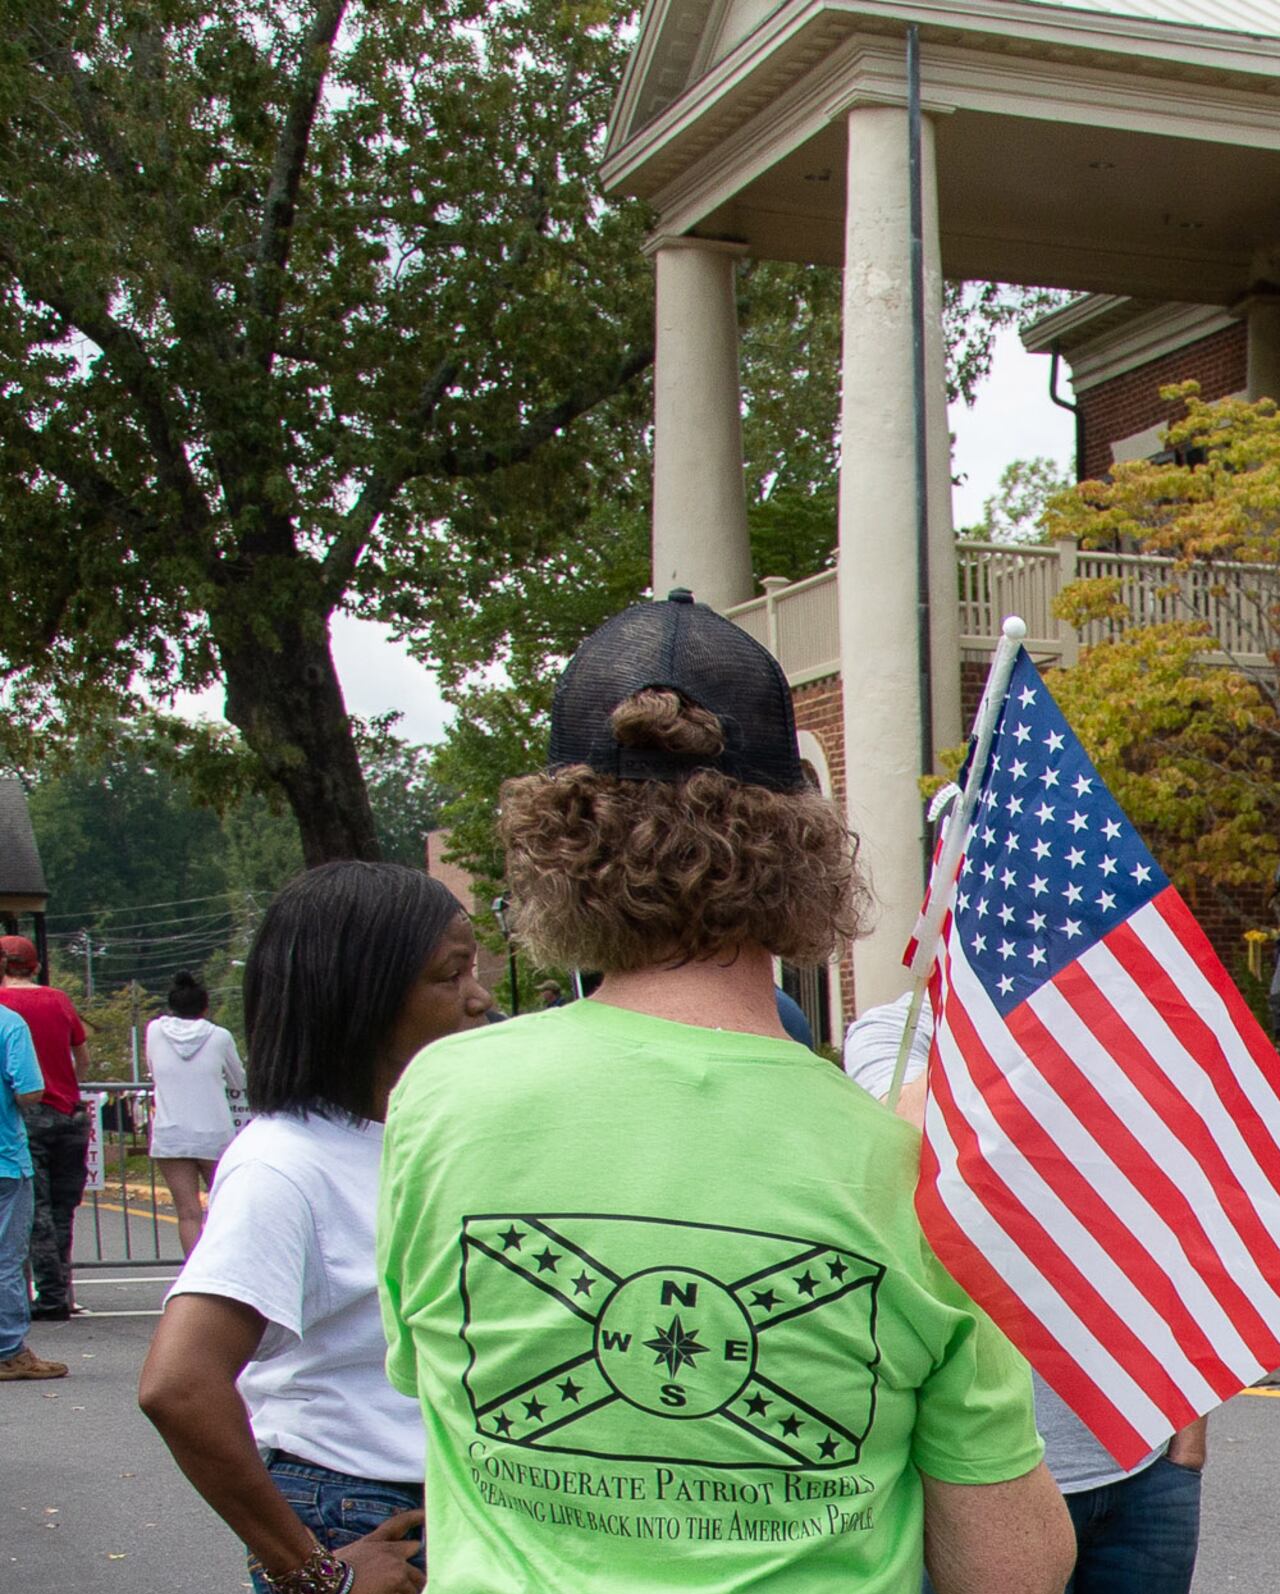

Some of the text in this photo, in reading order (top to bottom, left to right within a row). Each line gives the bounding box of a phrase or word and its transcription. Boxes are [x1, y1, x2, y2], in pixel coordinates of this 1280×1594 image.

[660, 1279, 698, 1308] N
[601, 1329, 749, 1362] W E
[659, 1383, 688, 1408] S
[468, 1440, 876, 1505] CONFEDERATE PATRIOT REBELS
[549, 1502, 586, 1529] LIFE
[586, 1510, 632, 1538] BACK
[635, 1515, 681, 1541] INTO
[685, 1516, 723, 1541] THE
[727, 1508, 823, 1543] AMERICAN
